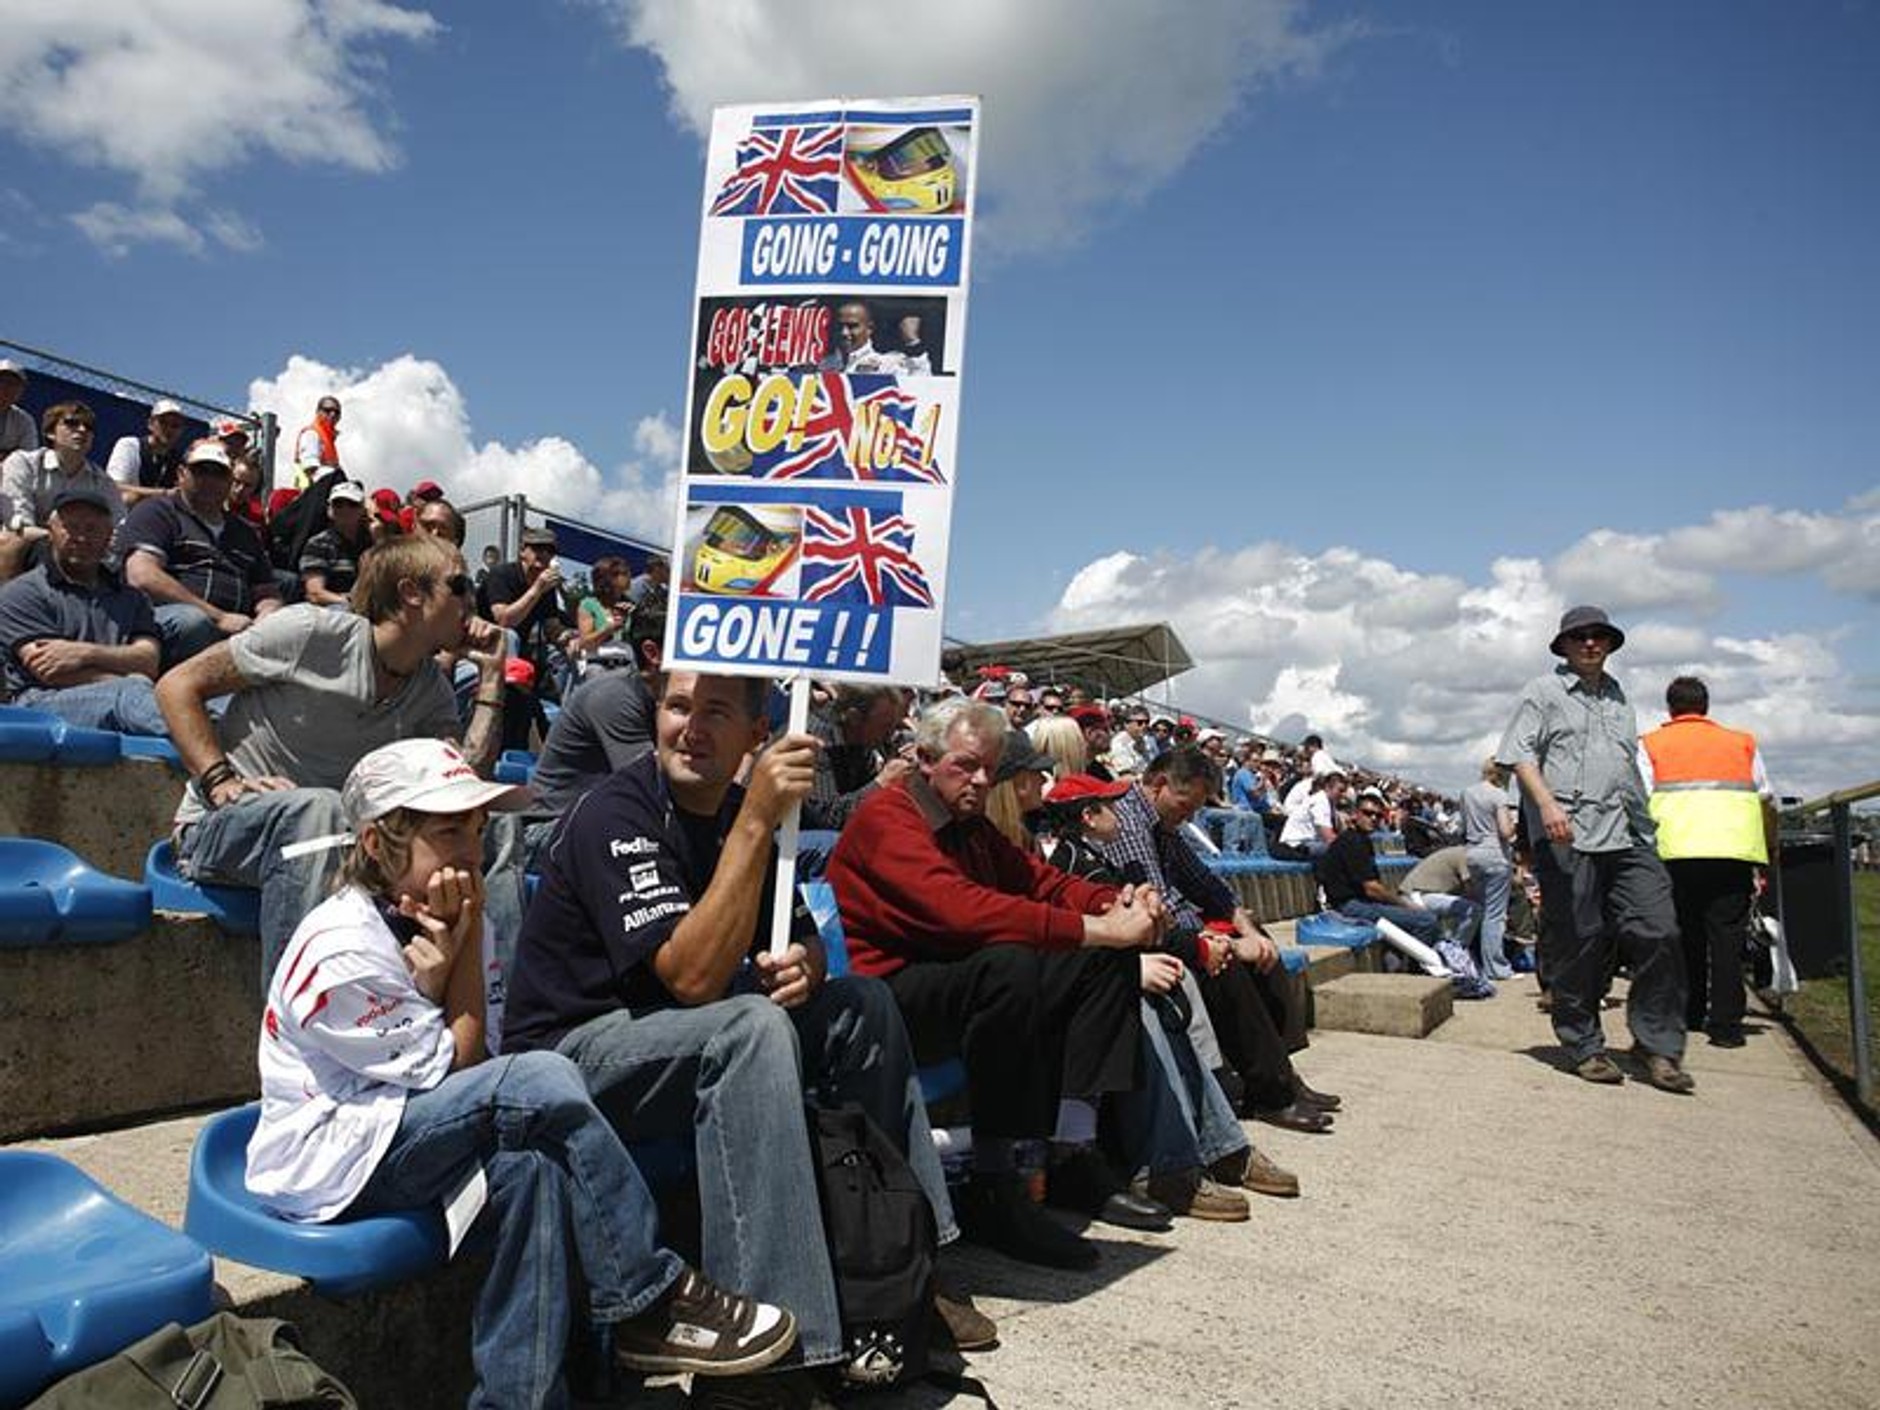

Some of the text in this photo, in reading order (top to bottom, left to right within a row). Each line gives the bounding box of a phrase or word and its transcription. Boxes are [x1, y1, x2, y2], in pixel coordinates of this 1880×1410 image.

[752, 222, 838, 278] GOING
[858, 223, 949, 278] GOING
[759, 305, 830, 367] LEWIS
[702, 373, 818, 453] GO!
[919, 403, 942, 468] 1
[682, 603, 821, 664] GONE
[623, 902, 675, 932] Allianz
